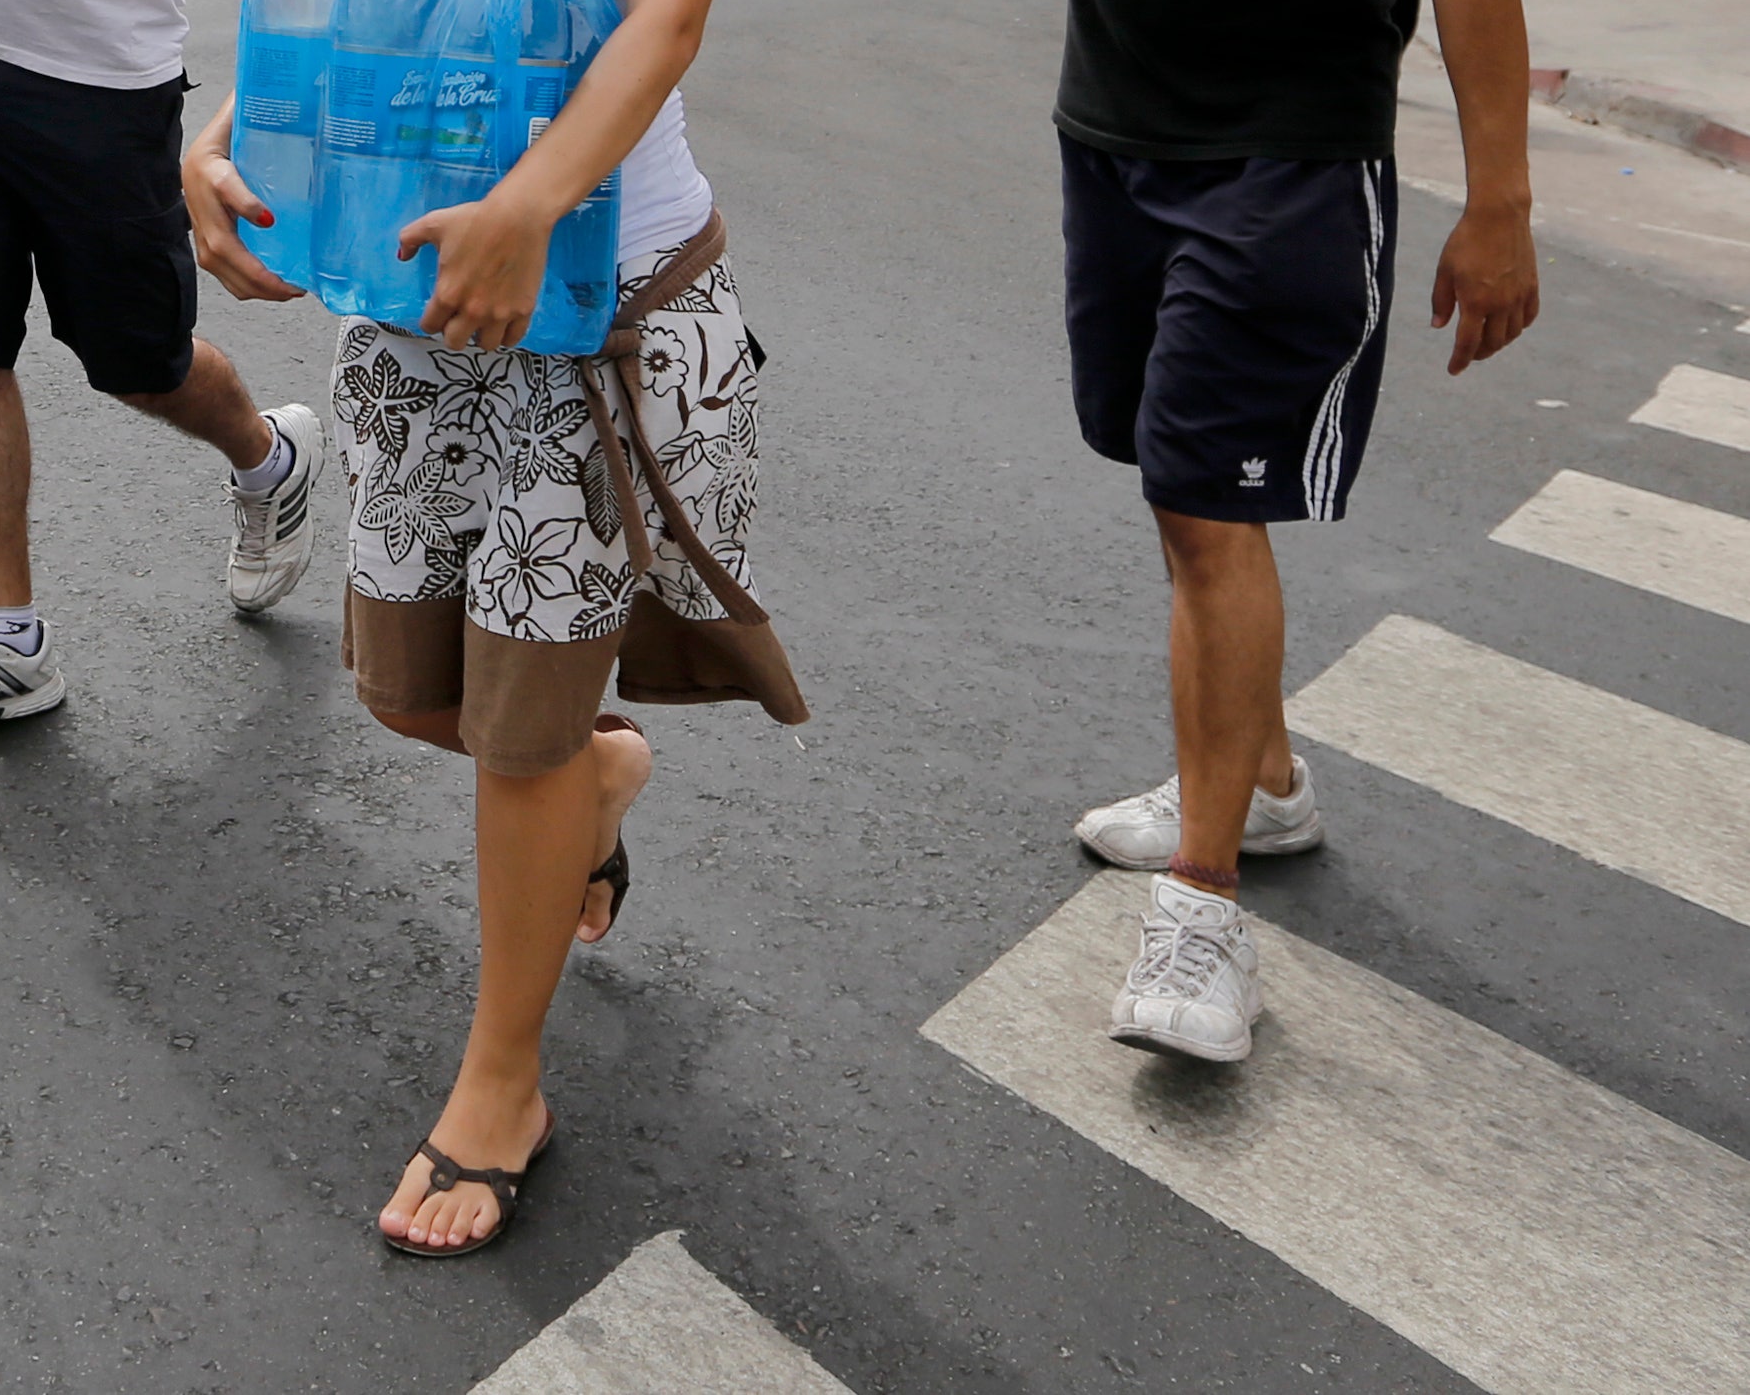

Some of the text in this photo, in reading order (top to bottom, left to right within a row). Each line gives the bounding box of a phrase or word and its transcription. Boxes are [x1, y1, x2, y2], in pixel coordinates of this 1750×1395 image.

[390, 84, 412, 107] de
[444, 85, 459, 107] la
[458, 82, 502, 107] Cruz
